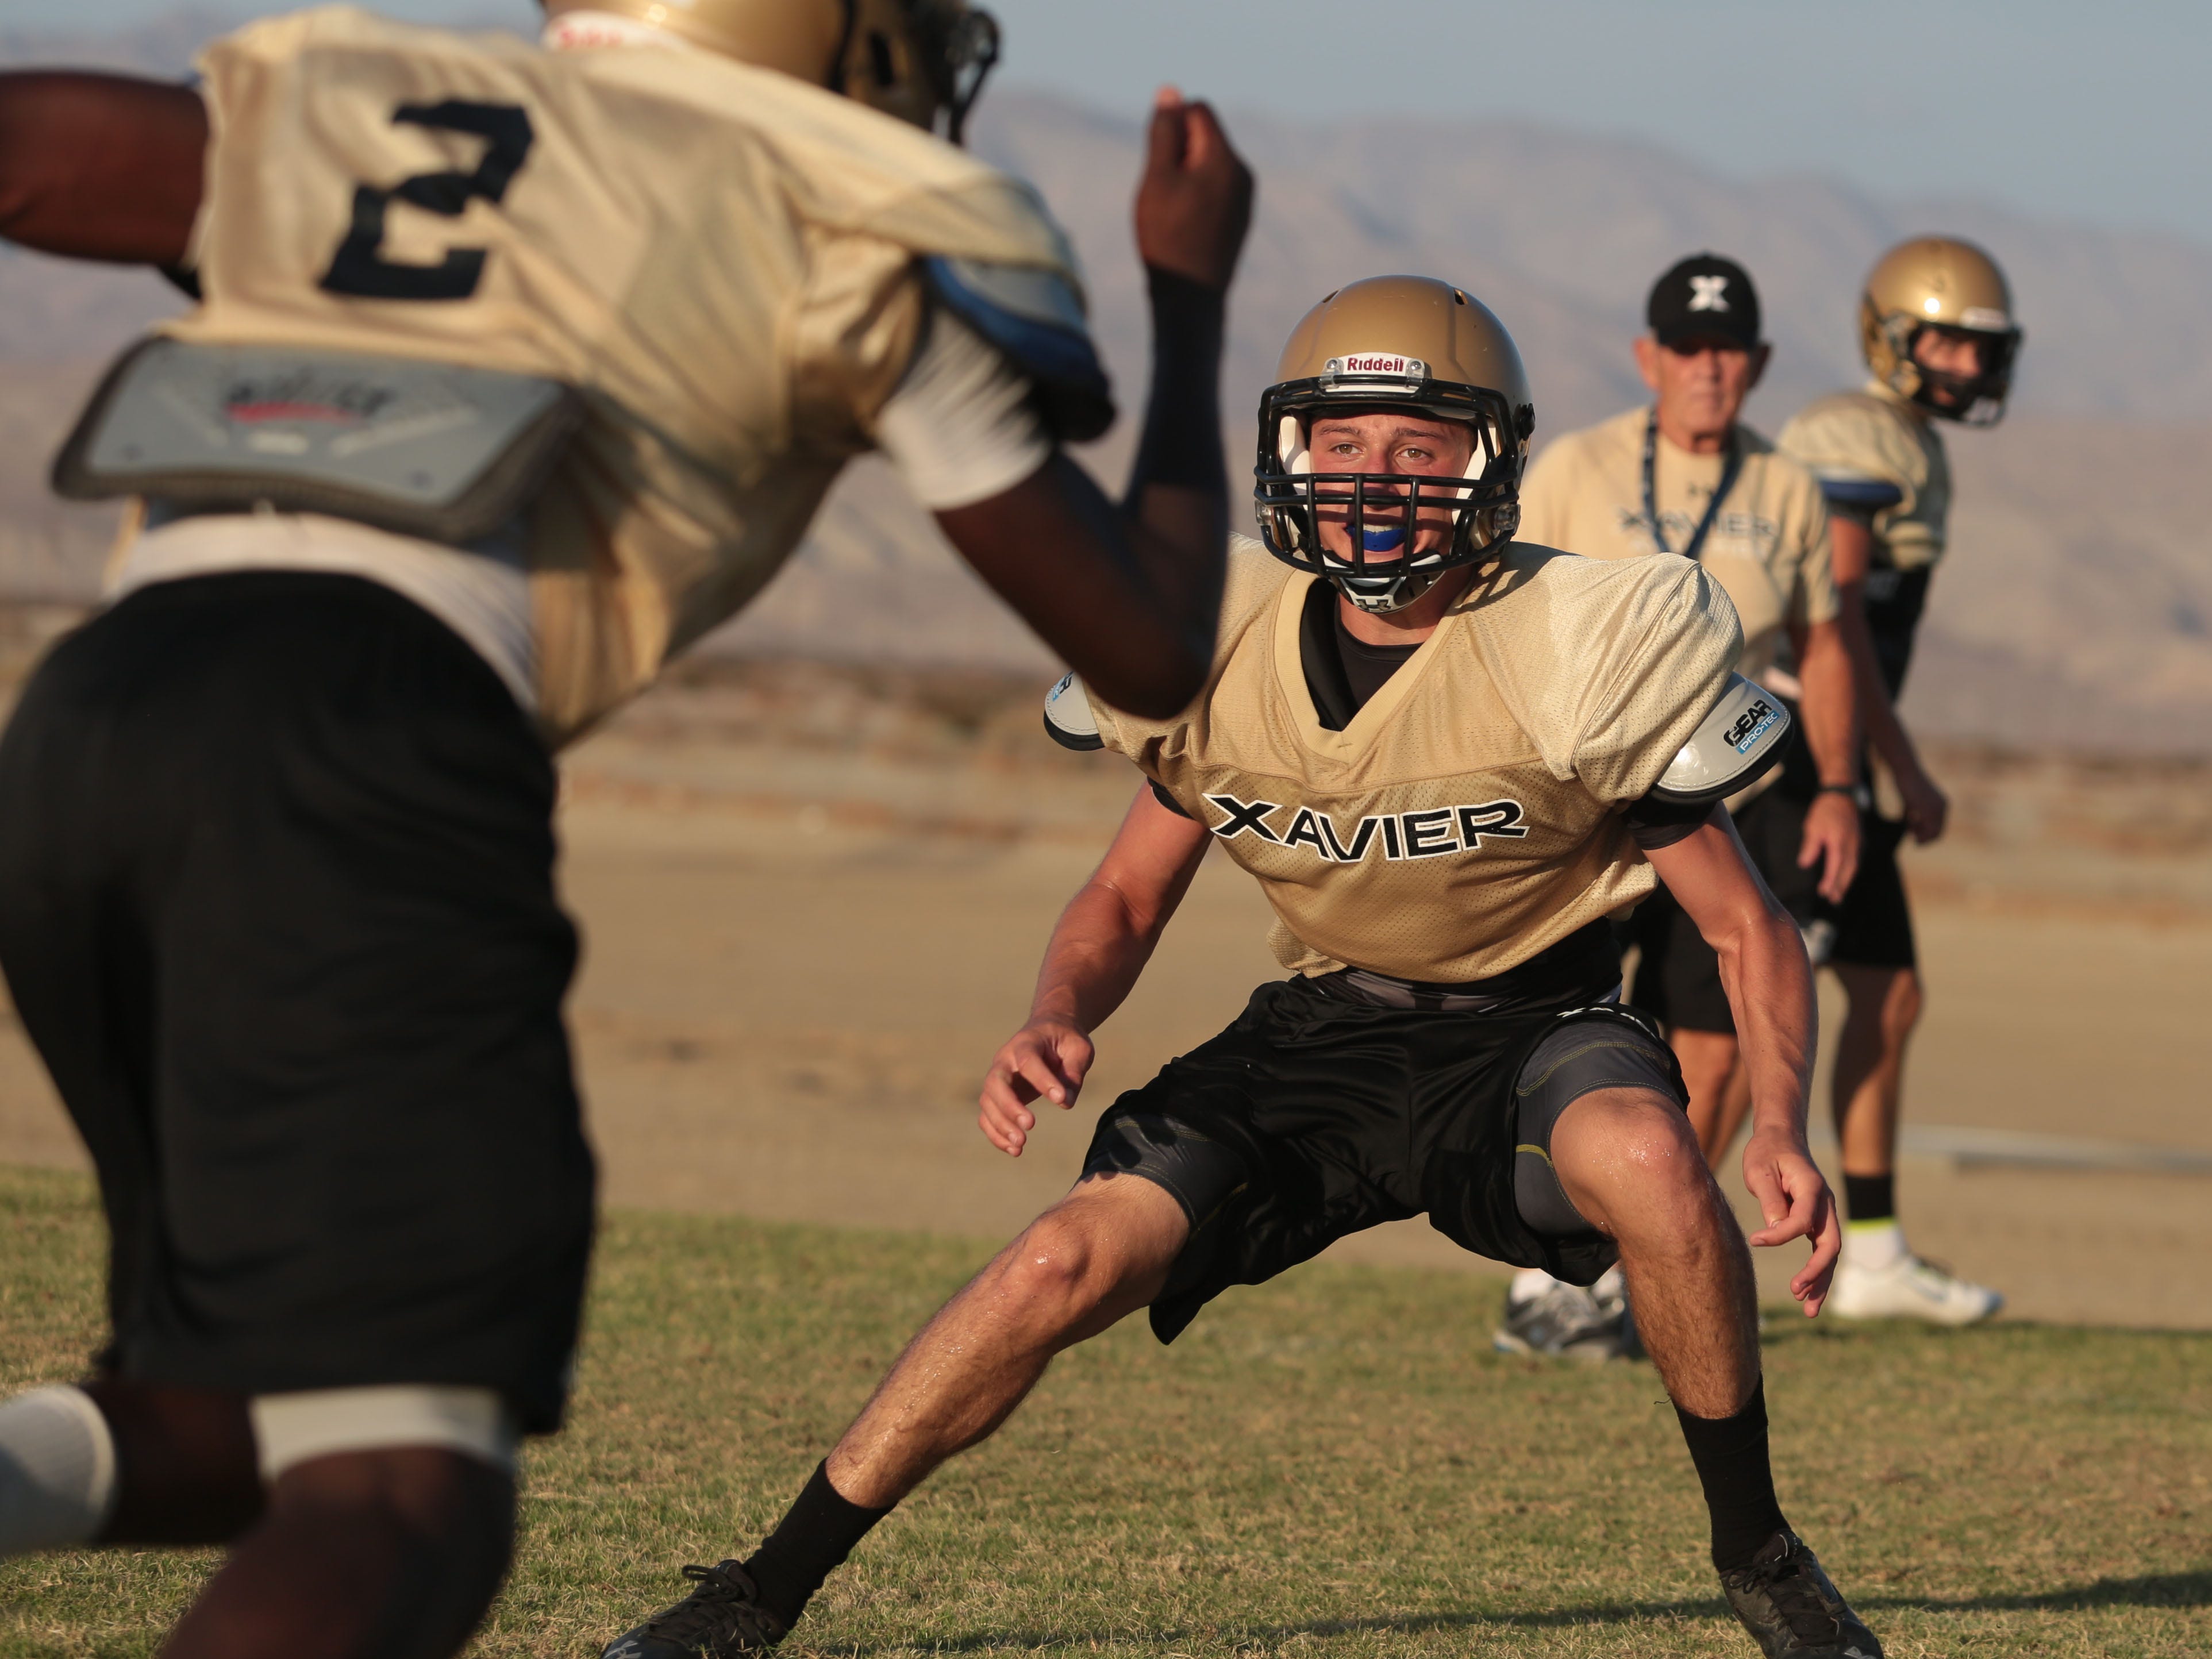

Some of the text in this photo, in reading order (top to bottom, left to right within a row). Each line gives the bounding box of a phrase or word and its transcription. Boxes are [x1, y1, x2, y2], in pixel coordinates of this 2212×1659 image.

[318, 95, 536, 300] 2
[1686, 275, 1730, 313] X
[1347, 357, 1405, 372] Riddell
[1723, 699, 1773, 747] GEAR
[1739, 712, 1779, 752] PRO-TEC
[1202, 793, 1530, 863] XAVIER
